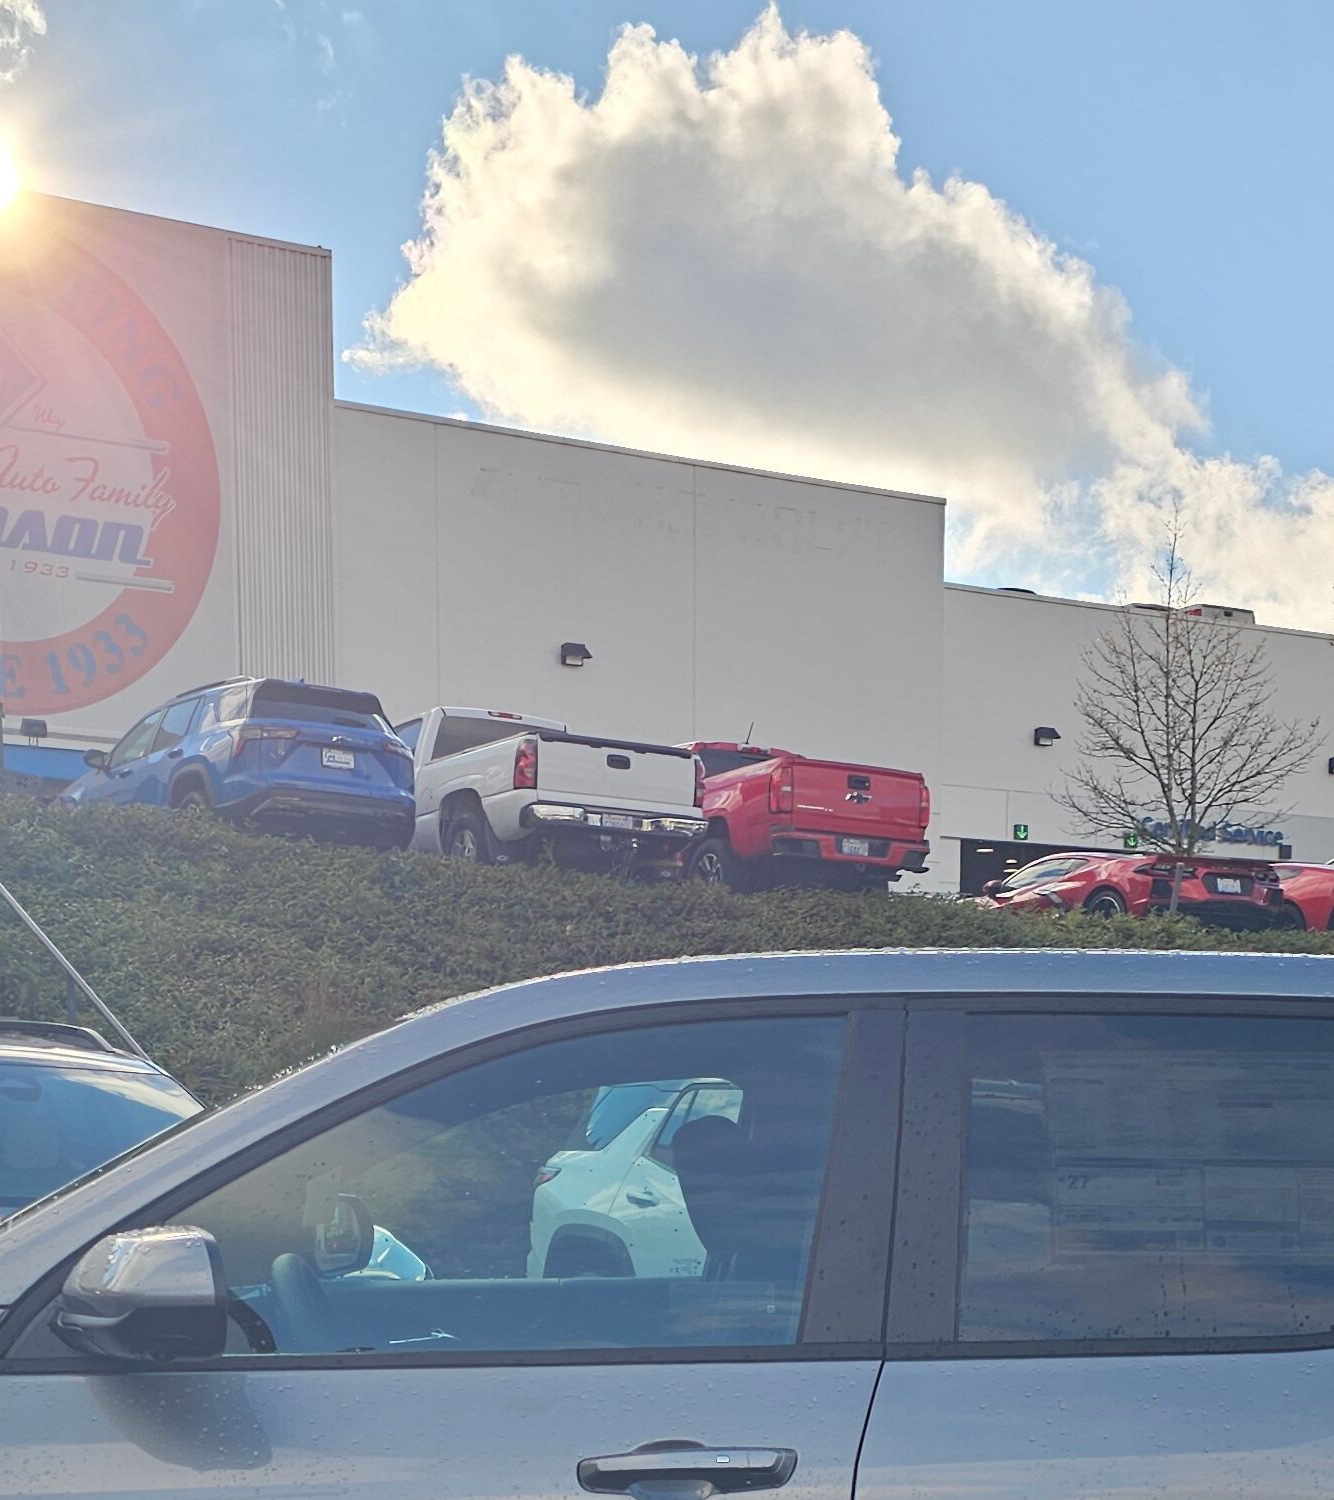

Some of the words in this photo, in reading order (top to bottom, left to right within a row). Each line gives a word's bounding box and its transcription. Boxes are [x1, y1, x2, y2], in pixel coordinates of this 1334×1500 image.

[33, 404, 66, 433] Way
[66, 457, 177, 528] Family
[10, 559, 70, 579] 1933
[43, 612, 149, 695] 1933
